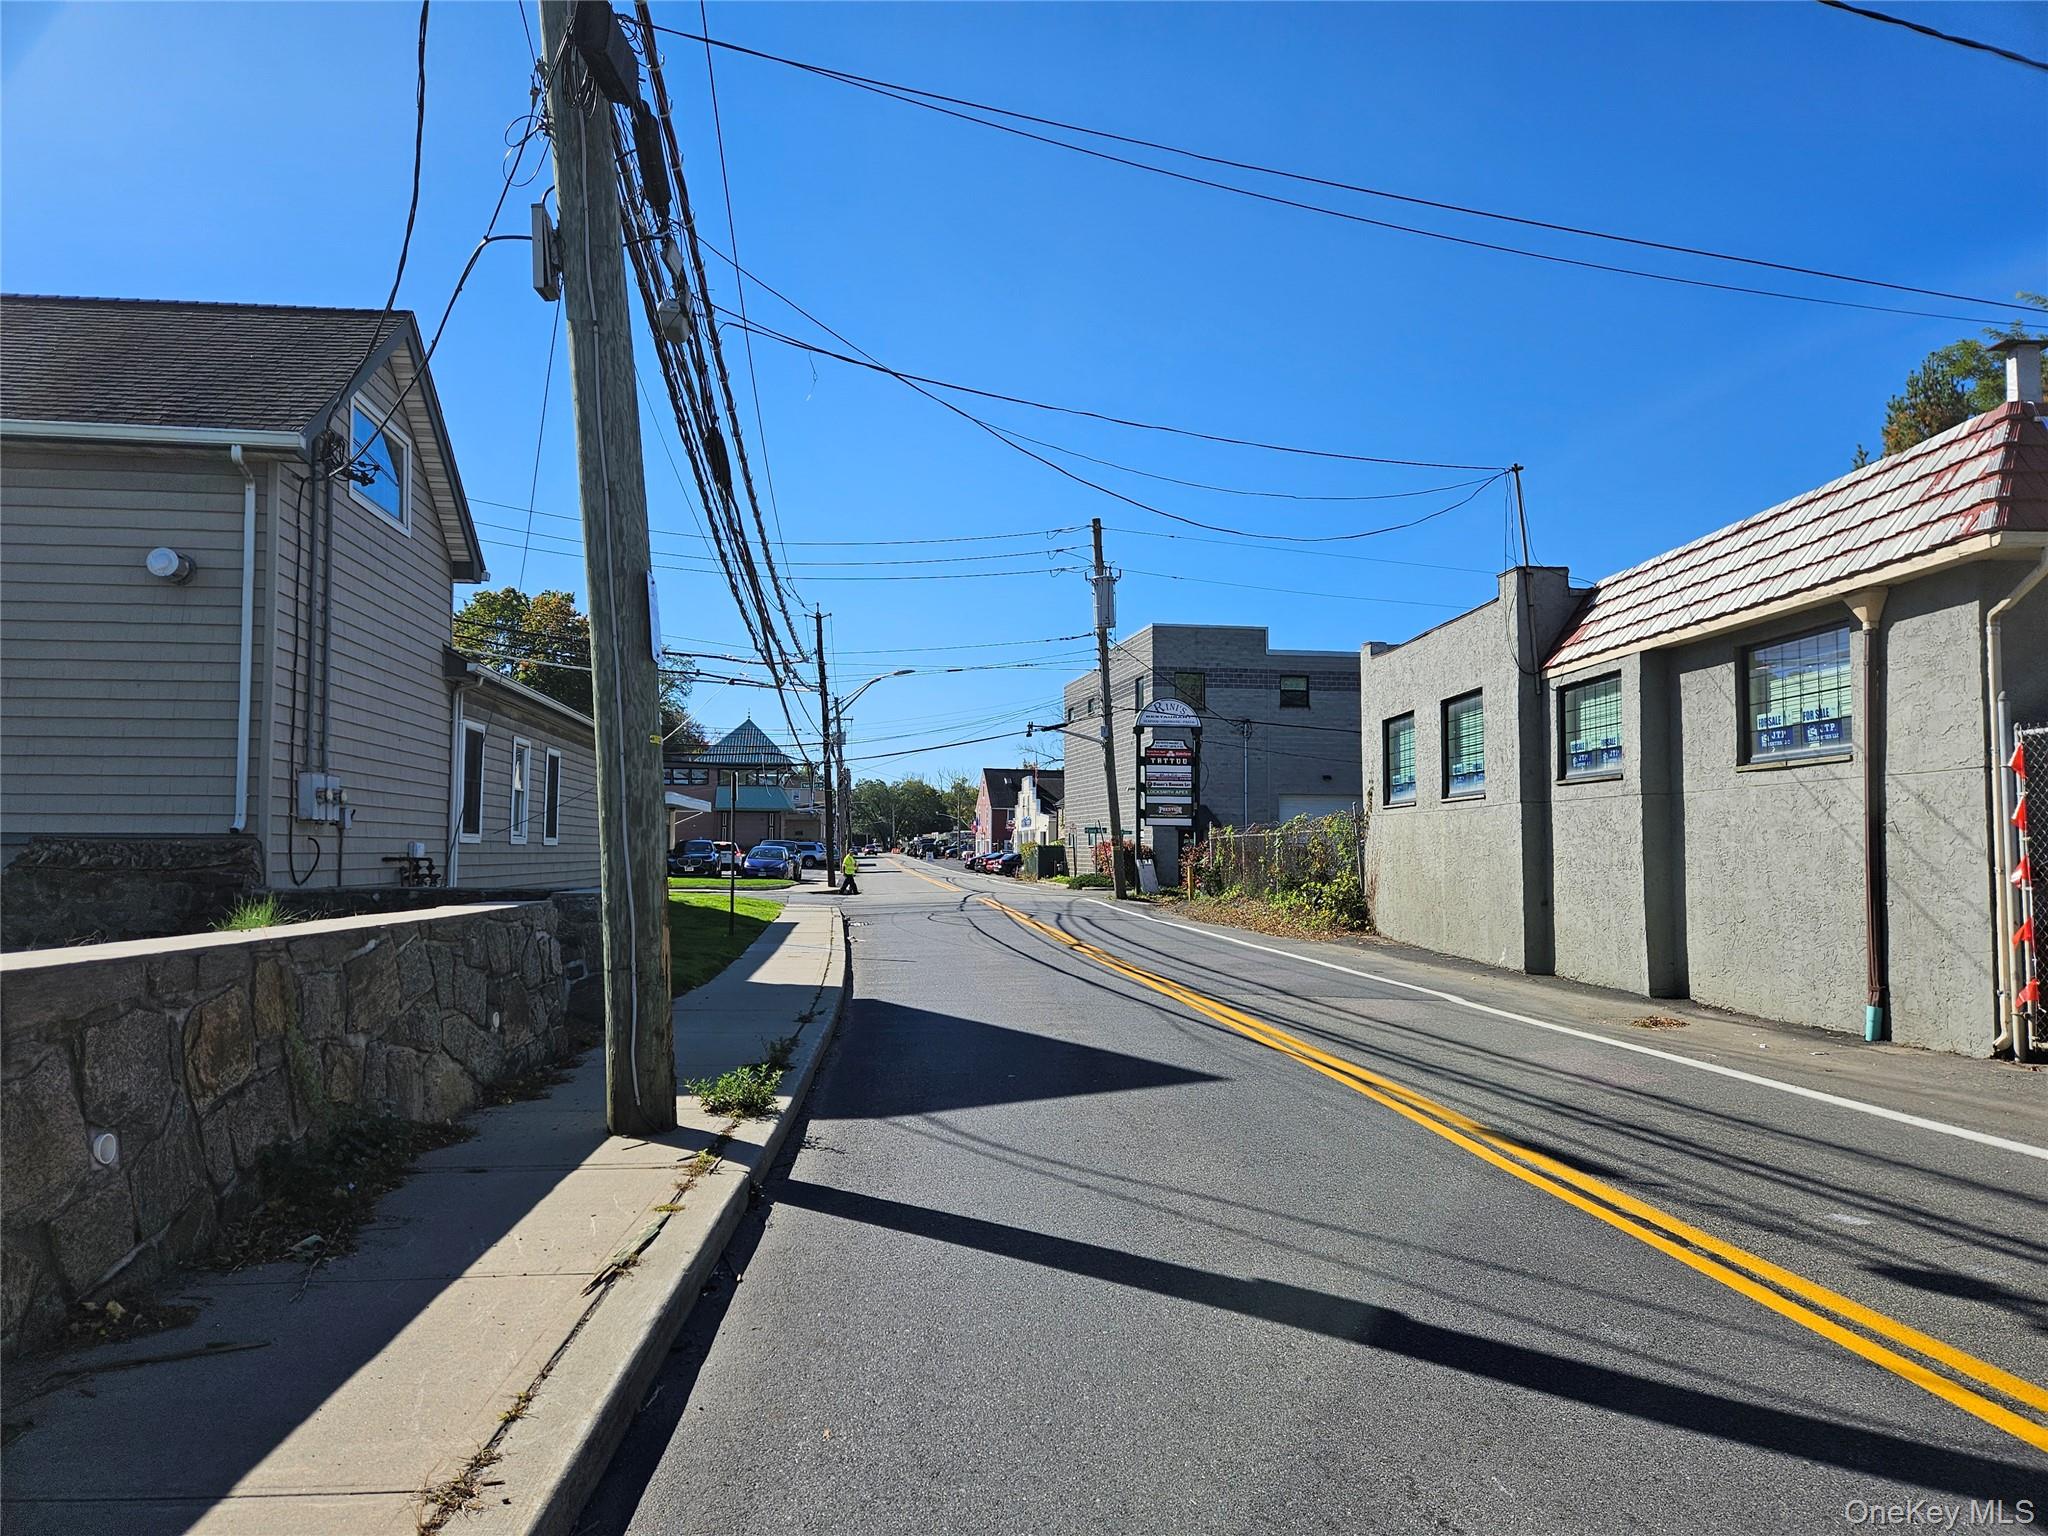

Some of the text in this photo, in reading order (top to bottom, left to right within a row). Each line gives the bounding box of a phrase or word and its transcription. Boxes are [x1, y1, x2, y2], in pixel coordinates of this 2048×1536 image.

[1153, 701, 1187, 714] RINI'S
[1803, 707, 1829, 721] FOR SALE
